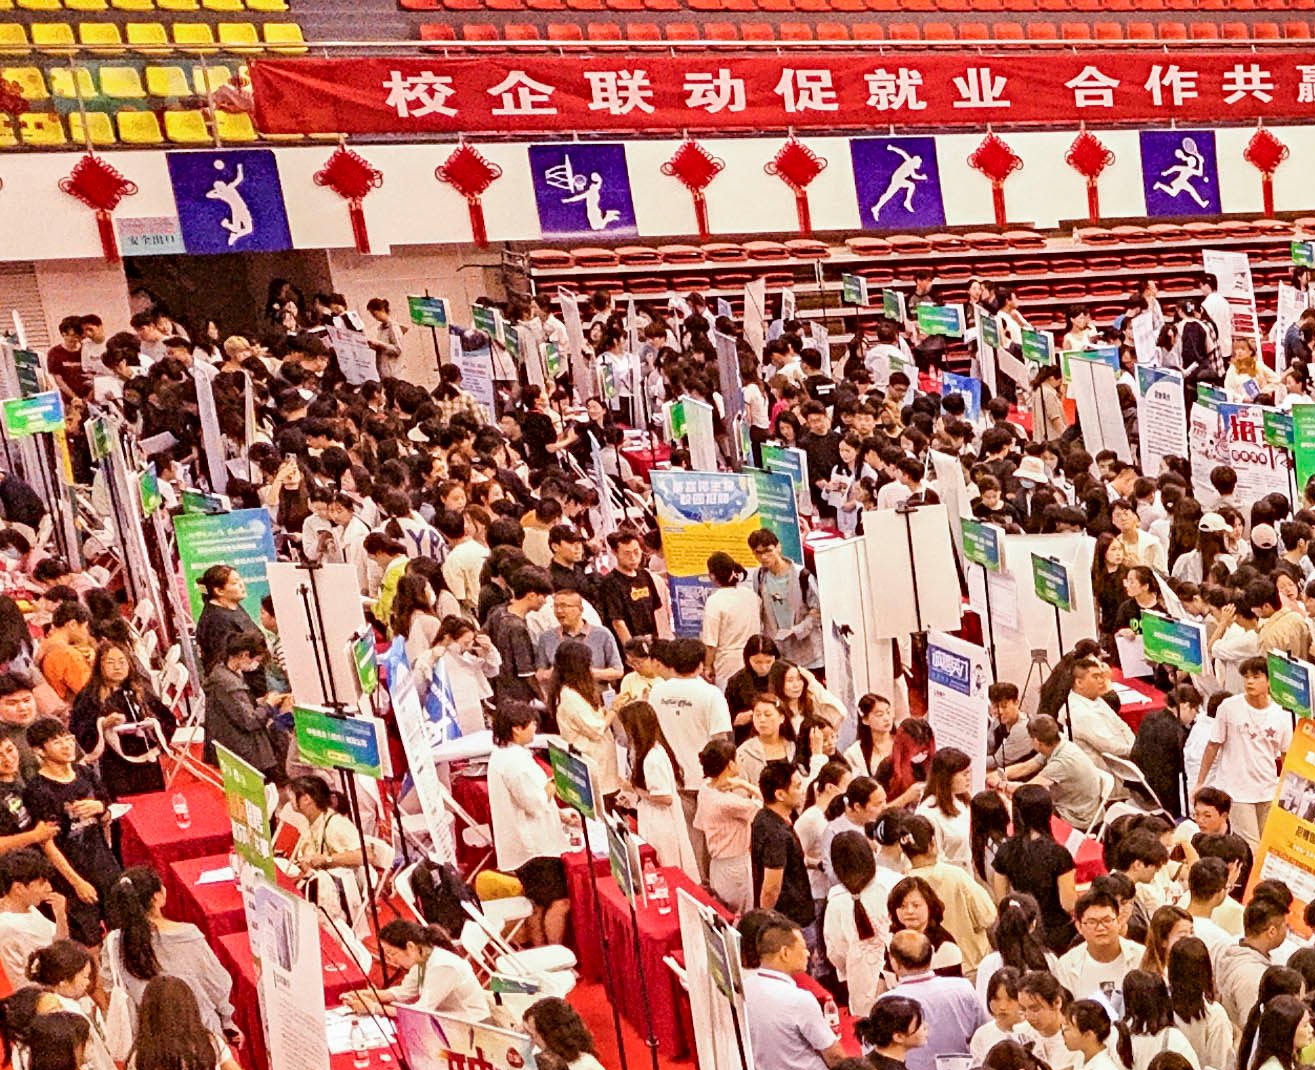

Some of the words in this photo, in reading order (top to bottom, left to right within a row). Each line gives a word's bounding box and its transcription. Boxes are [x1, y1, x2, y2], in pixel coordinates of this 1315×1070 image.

[382, 66, 1010, 119] 校企联动促就业
